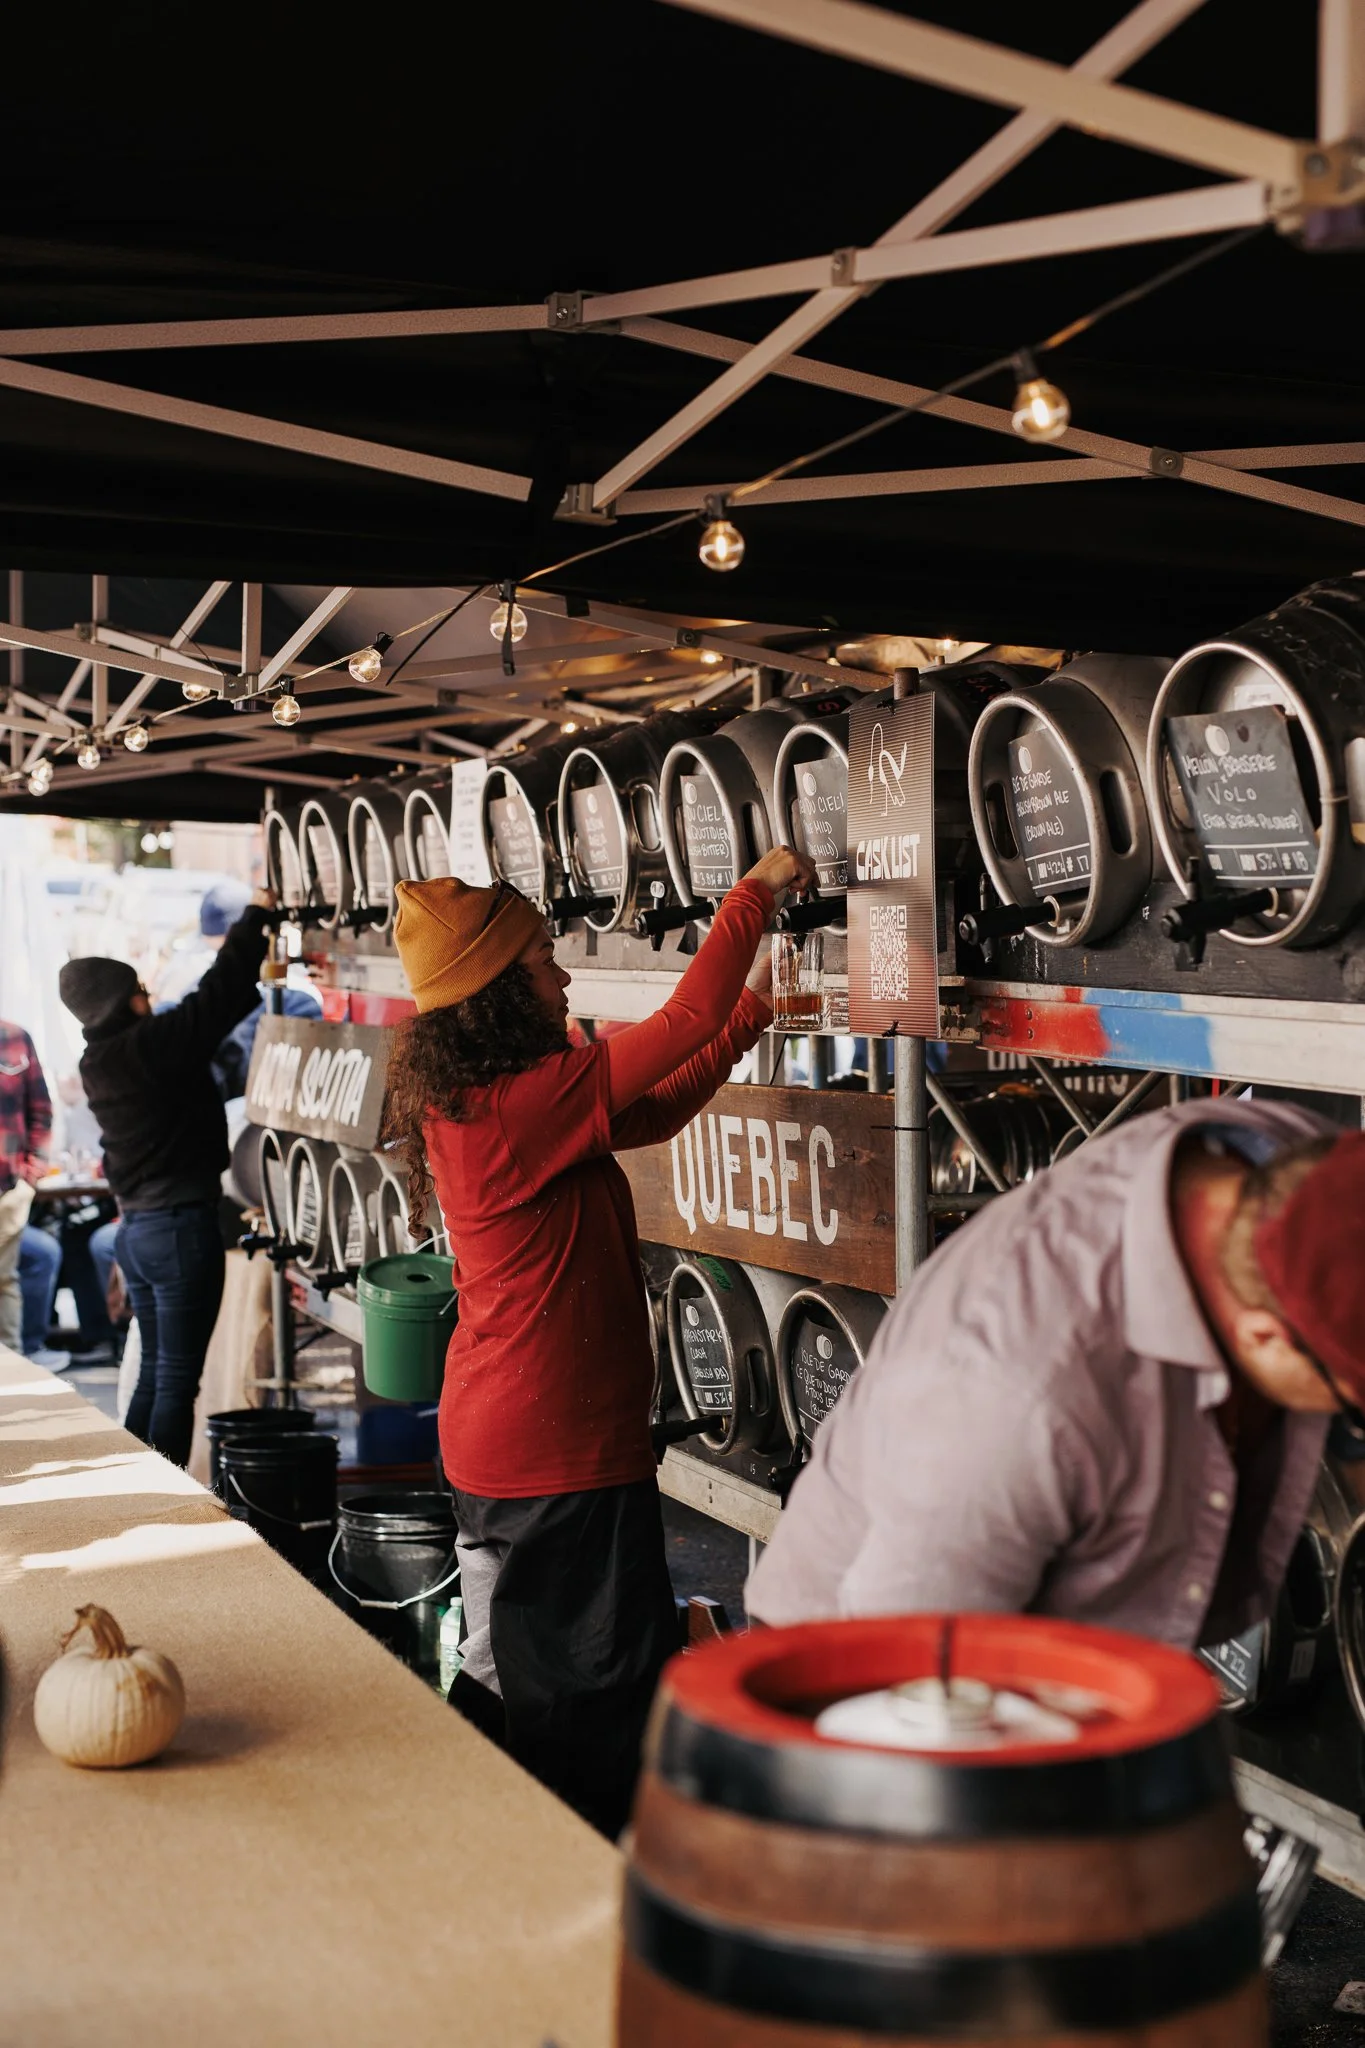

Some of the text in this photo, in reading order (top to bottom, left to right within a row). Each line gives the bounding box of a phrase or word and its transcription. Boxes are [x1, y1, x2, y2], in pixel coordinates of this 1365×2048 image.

[1028, 769, 1052, 789] GARDE
[1053, 790, 1069, 806] ALE
[1045, 815, 1064, 836] ALE)
[856, 833, 920, 881] CASK LIST
[1076, 855, 1090, 873] 17
[297, 1046, 372, 1128] SCOTIA
[670, 1112, 839, 1246] QUEBEC
[813, 1357, 825, 1372] DE
[796, 1363, 803, 1379] CE
[804, 1368, 816, 1387] QUE
[825, 1396, 836, 1410] LES
